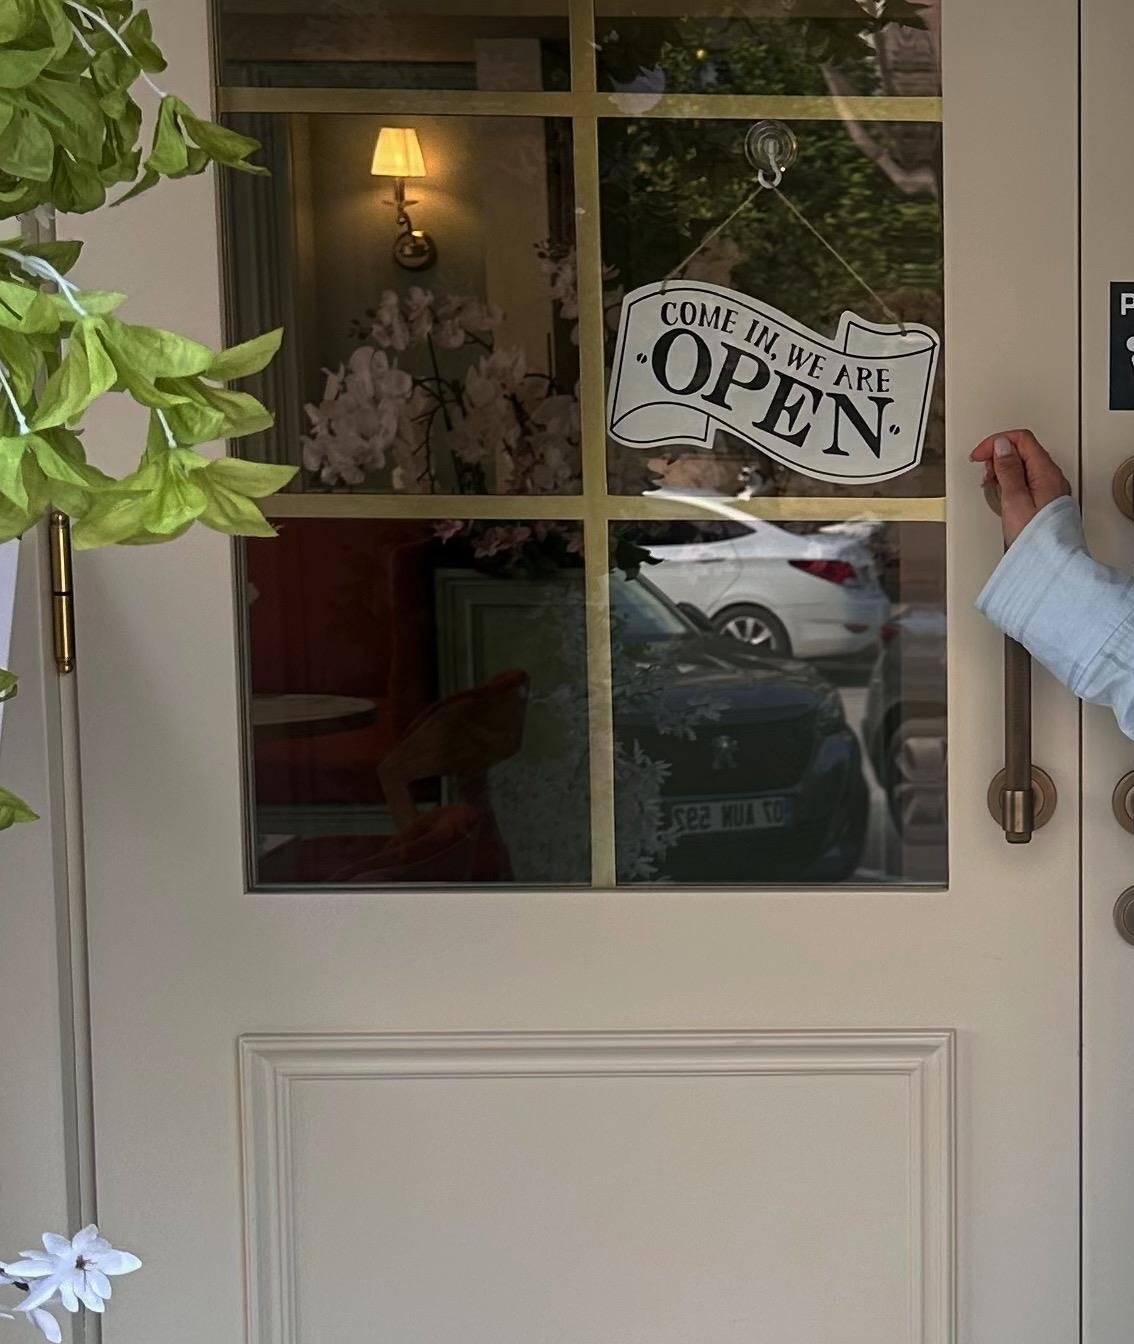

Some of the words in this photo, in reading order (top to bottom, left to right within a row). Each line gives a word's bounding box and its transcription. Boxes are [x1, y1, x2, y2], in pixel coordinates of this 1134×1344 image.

[651, 328, 895, 459] OPEN
[660, 301, 738, 334] COME
[743, 318, 780, 361] IN,
[787, 343, 826, 379] WE
[833, 364, 890, 393] ARE
